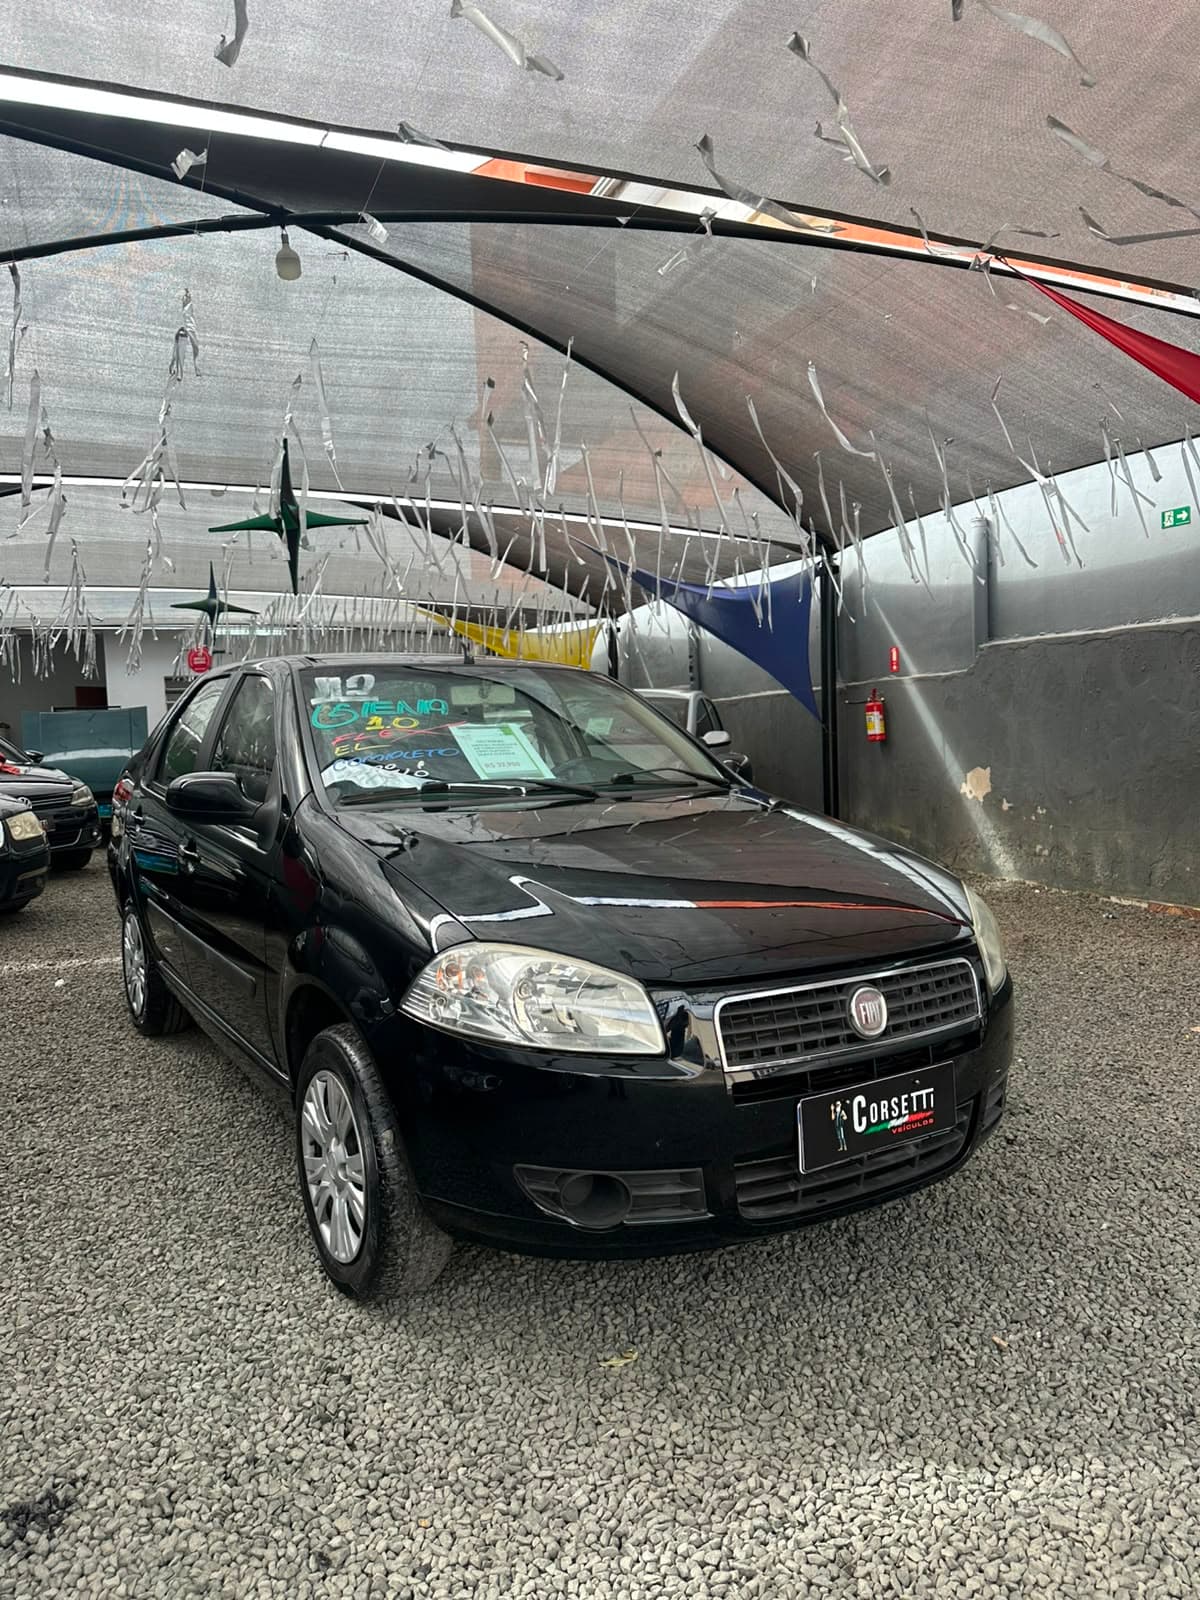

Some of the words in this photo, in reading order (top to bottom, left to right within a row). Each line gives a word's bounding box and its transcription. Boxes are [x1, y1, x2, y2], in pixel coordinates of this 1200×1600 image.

[311, 697, 449, 730] SIENA
[365, 715, 420, 731] 1.0
[332, 747, 460, 772] COMPLETO
[859, 1001, 881, 1025] FIAT
